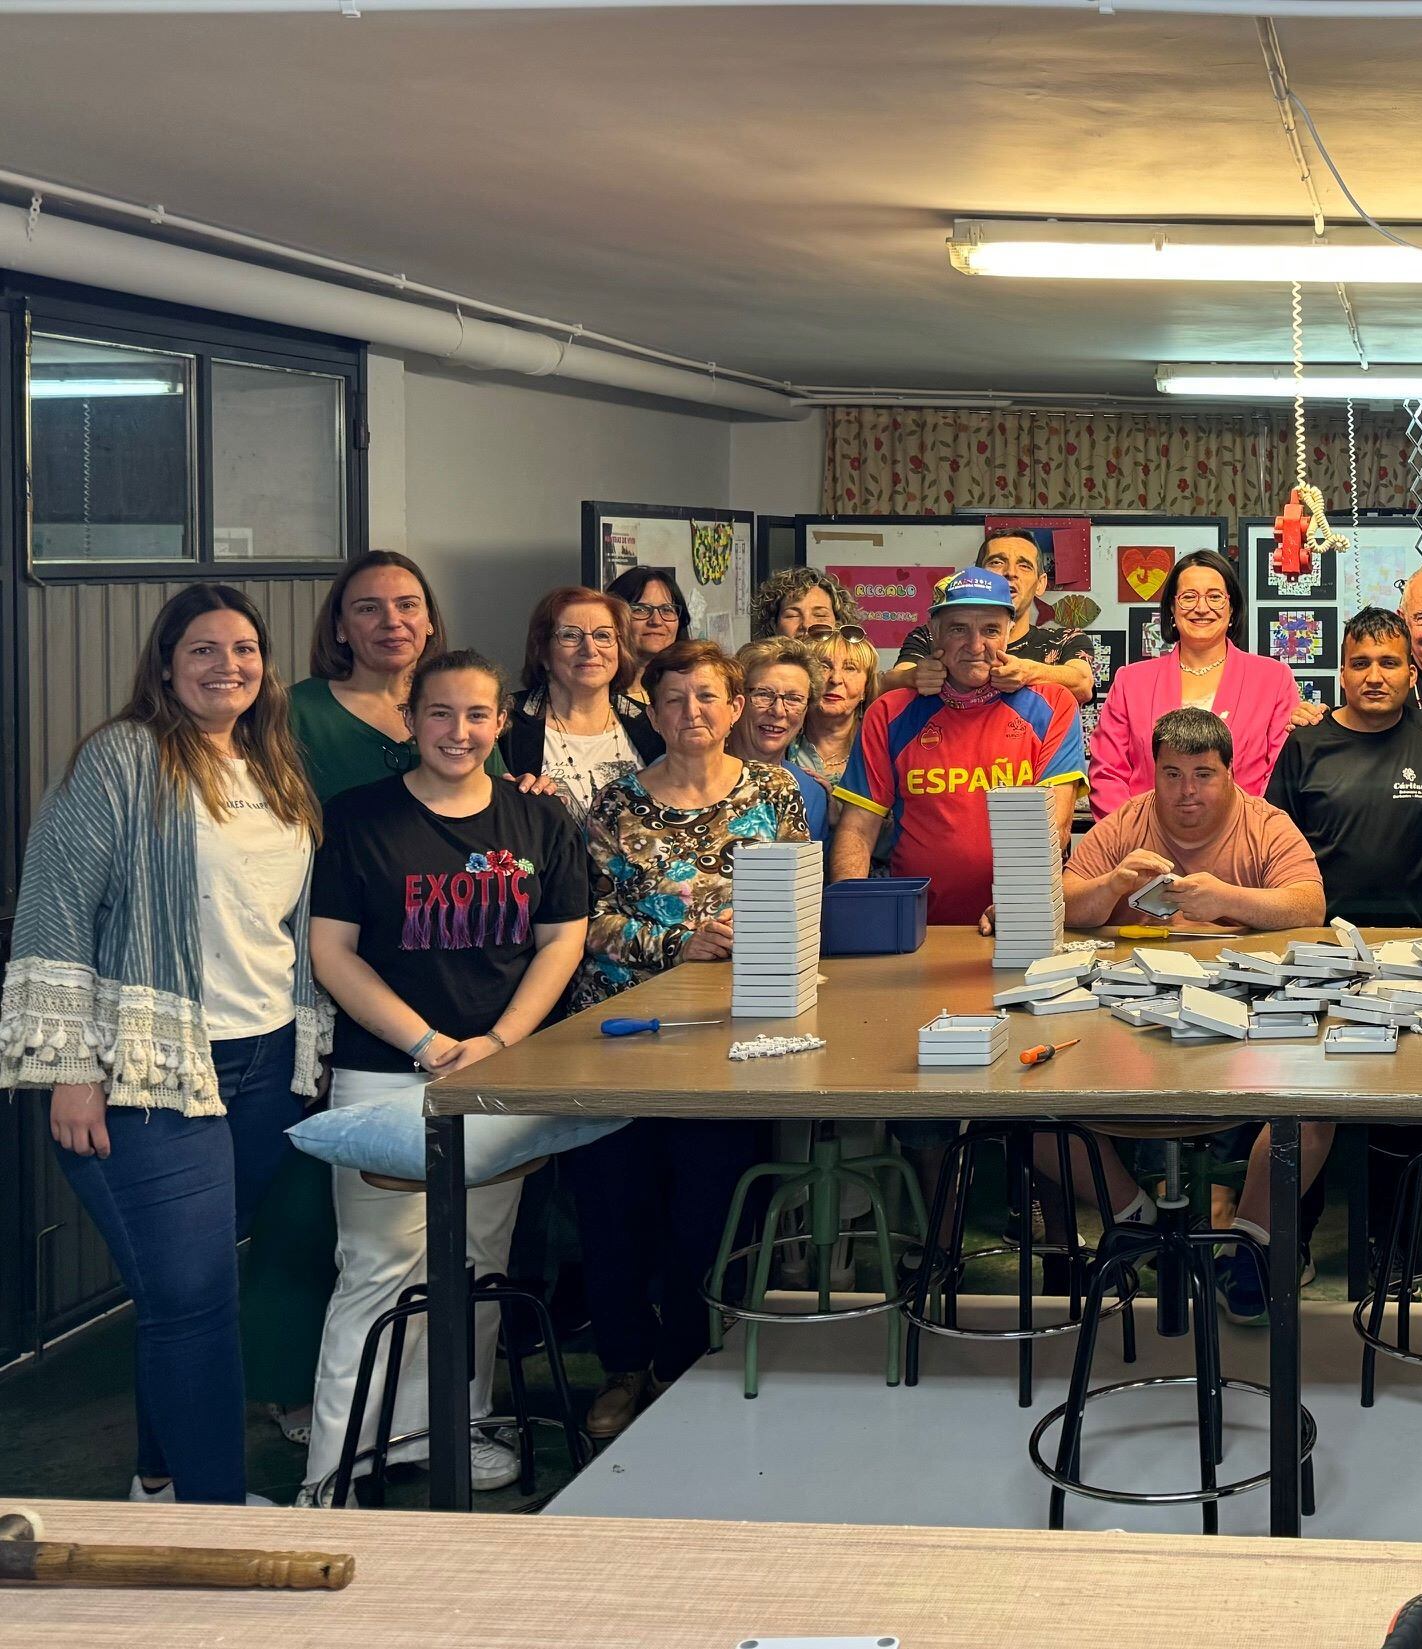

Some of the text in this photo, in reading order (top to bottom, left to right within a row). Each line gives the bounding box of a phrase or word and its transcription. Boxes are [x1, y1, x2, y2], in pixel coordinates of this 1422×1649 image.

[855, 584, 917, 598] REGALO
[906, 758, 1034, 795] ESPAÑA
[405, 869, 530, 909] EXOTIC
